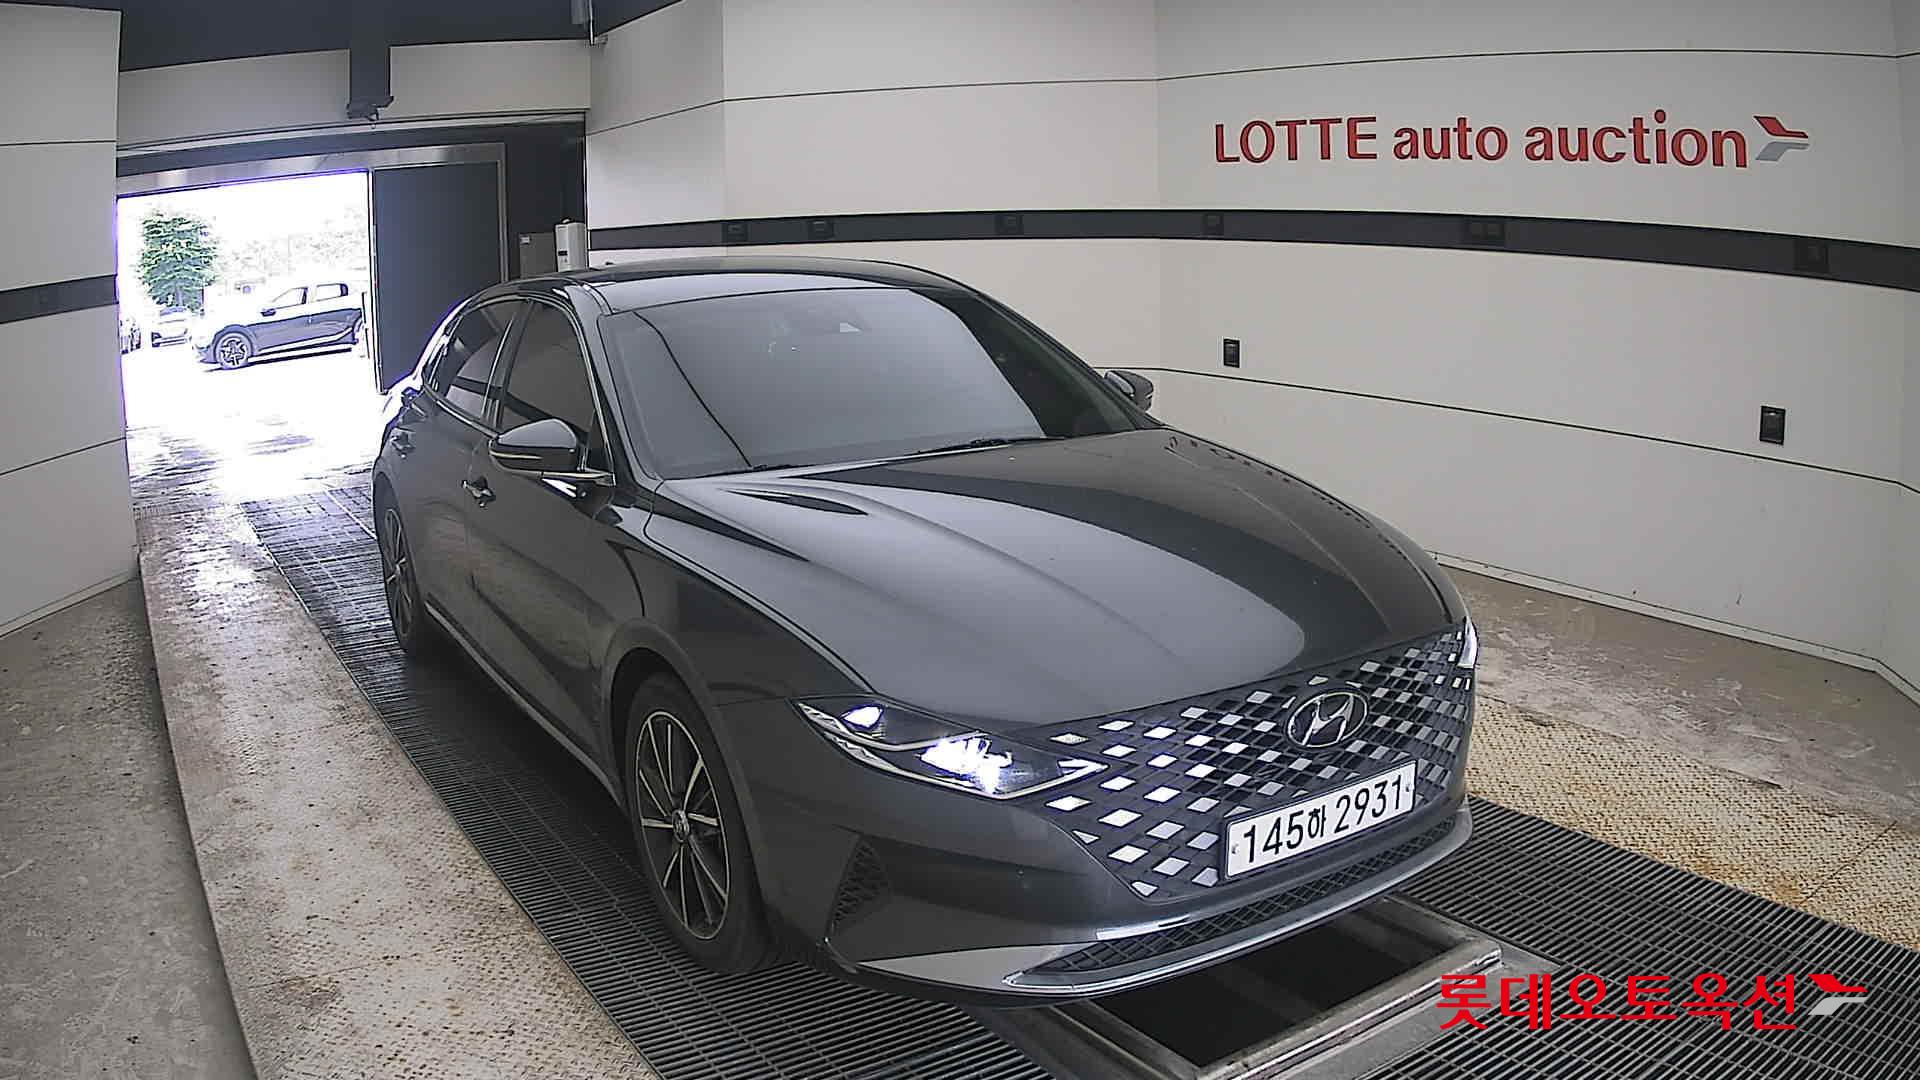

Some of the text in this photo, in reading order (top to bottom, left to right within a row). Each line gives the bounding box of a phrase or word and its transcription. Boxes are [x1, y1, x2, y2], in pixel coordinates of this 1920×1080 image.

[1214, 109, 1749, 169] LOTTE auto auction
[1243, 774, 1402, 864] 145하 2931
